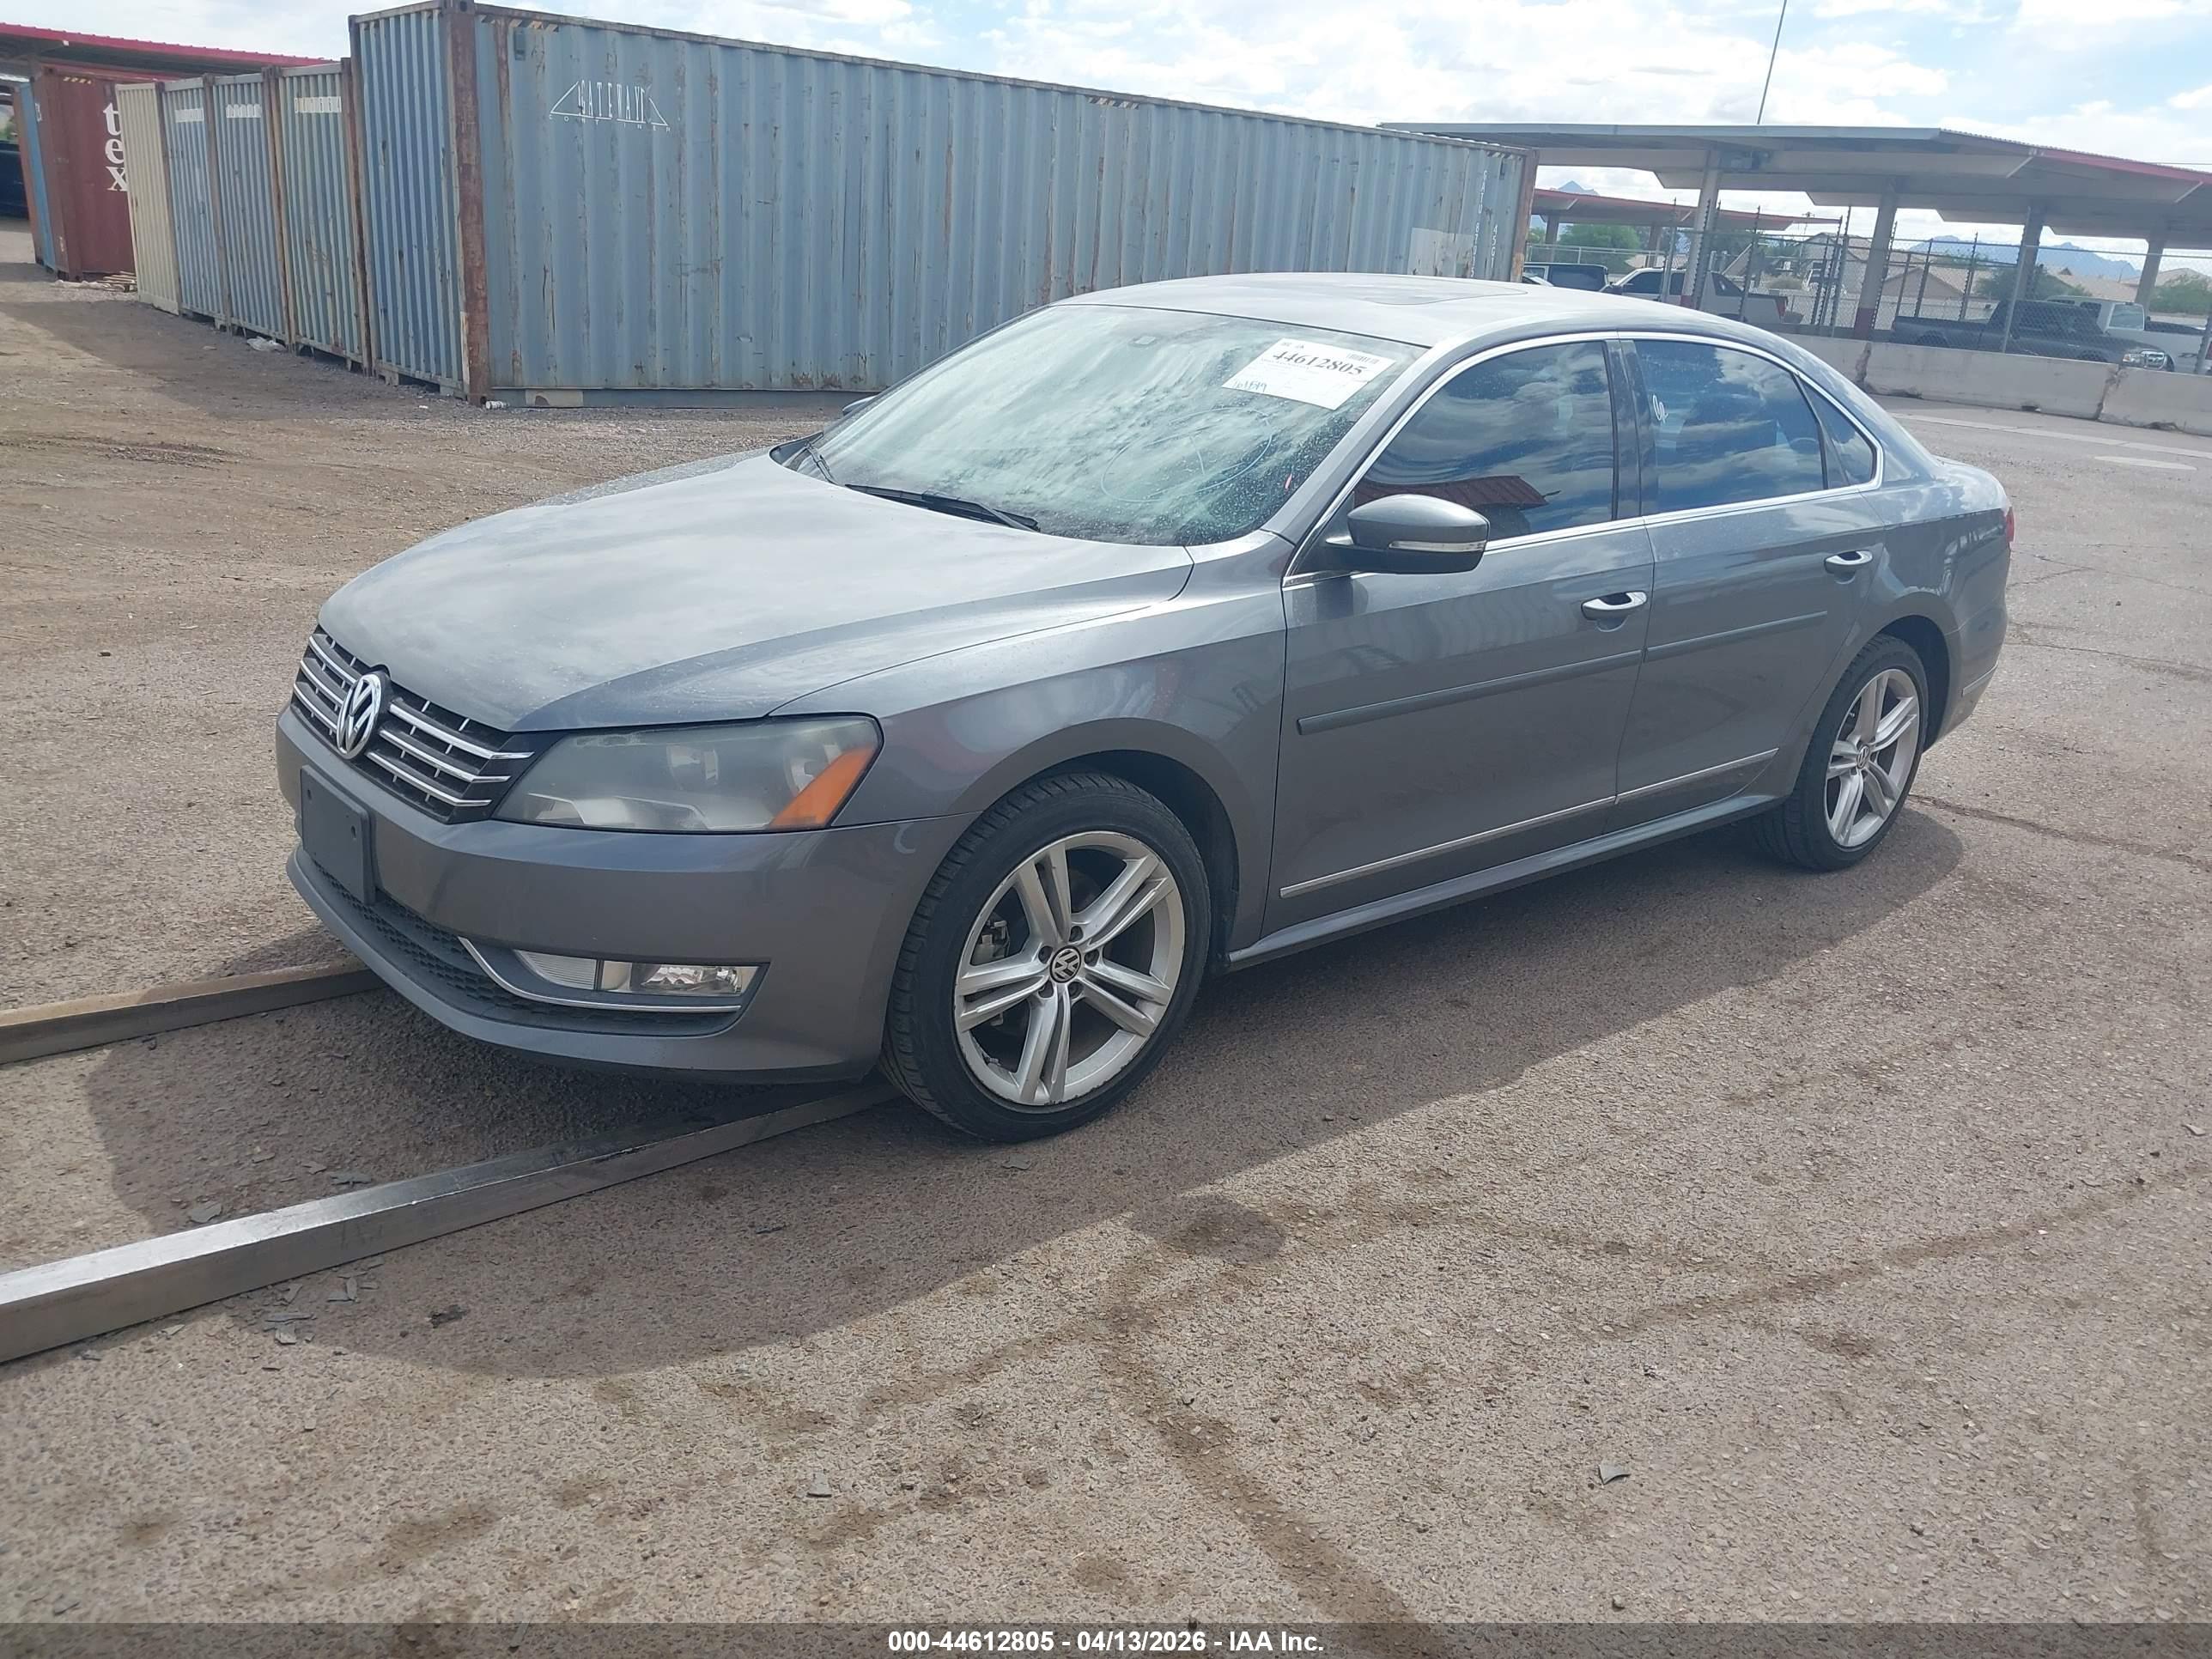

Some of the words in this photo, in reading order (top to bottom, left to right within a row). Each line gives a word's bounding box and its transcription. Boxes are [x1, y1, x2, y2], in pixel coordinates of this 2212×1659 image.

[580, 79, 641, 121] GATEWAY
[549, 113, 671, 132] CONTINER
[1273, 350, 1368, 375] 44612805
[1051, 946, 1081, 981] VW
